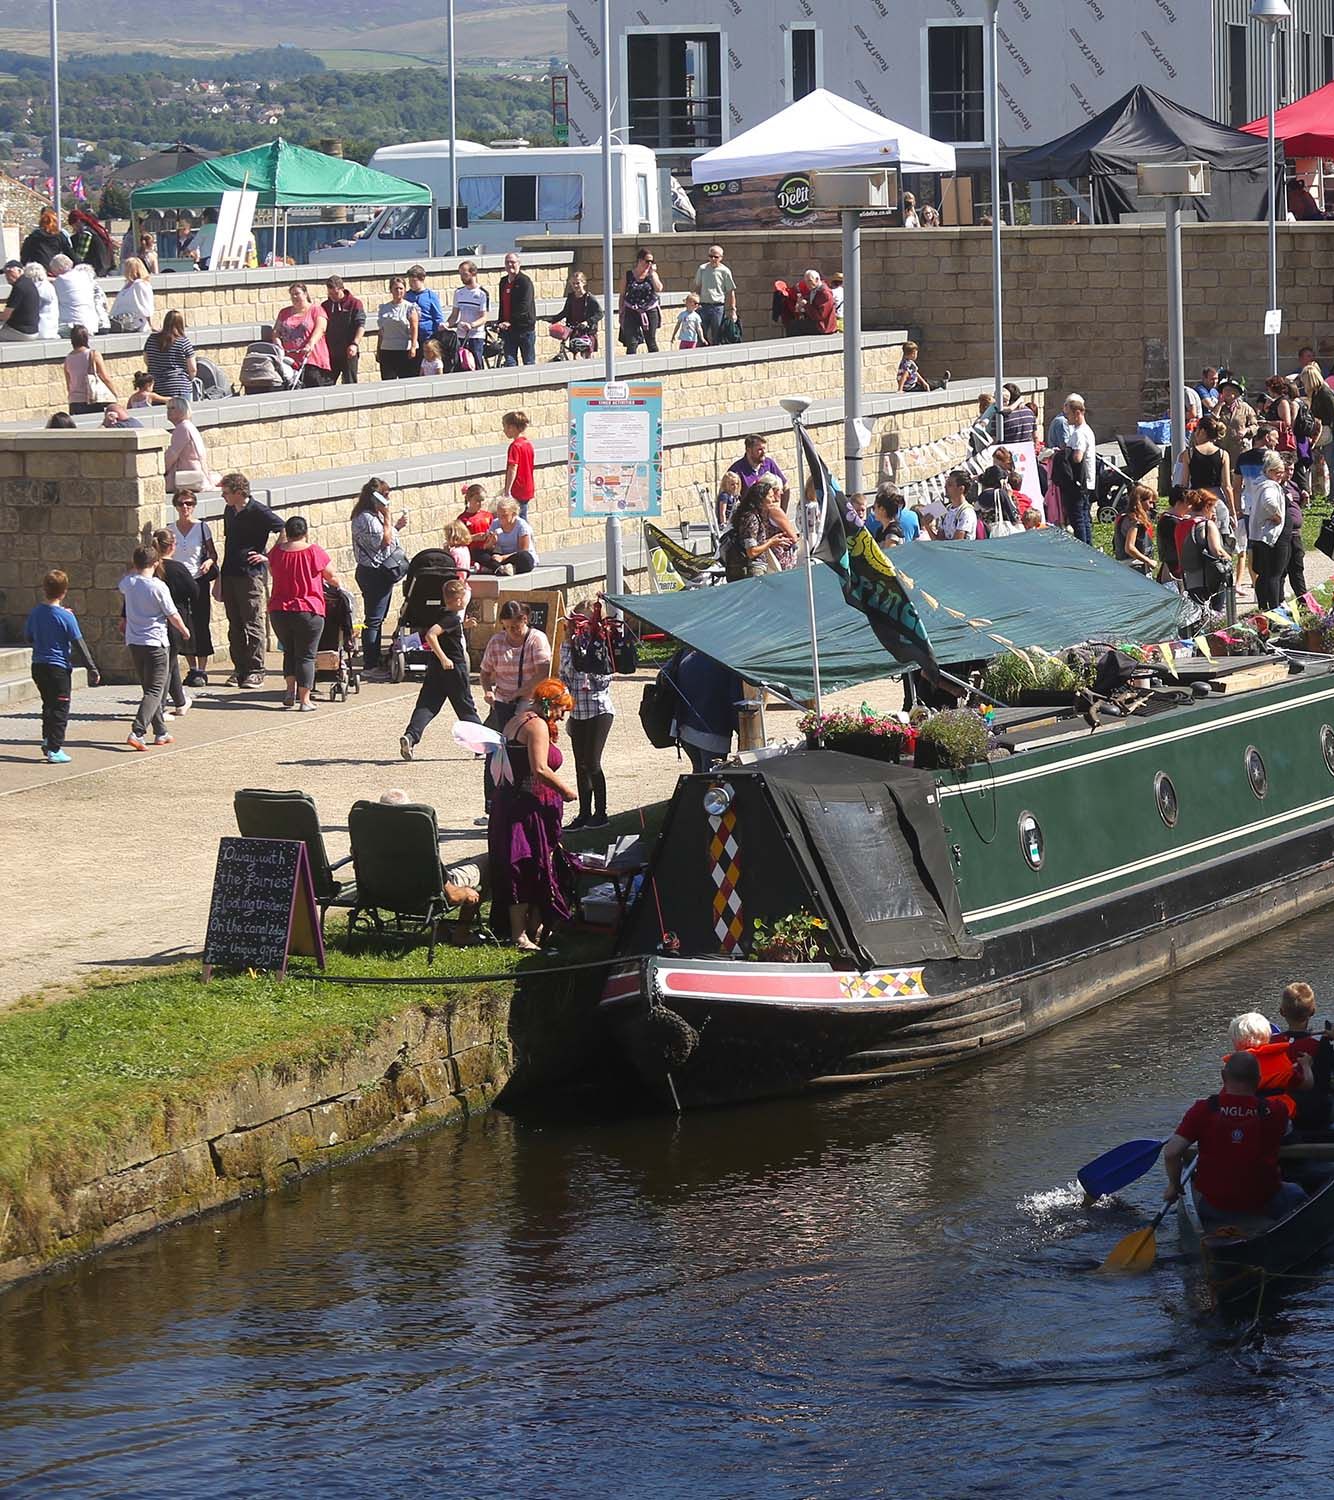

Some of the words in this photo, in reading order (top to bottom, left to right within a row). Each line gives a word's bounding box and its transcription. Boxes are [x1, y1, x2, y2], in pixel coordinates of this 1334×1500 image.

[259, 849, 286, 865] with
[220, 872, 241, 885] the
[243, 871, 289, 896] fairies
[226, 917, 242, 933] the
[244, 919, 268, 935] canal
